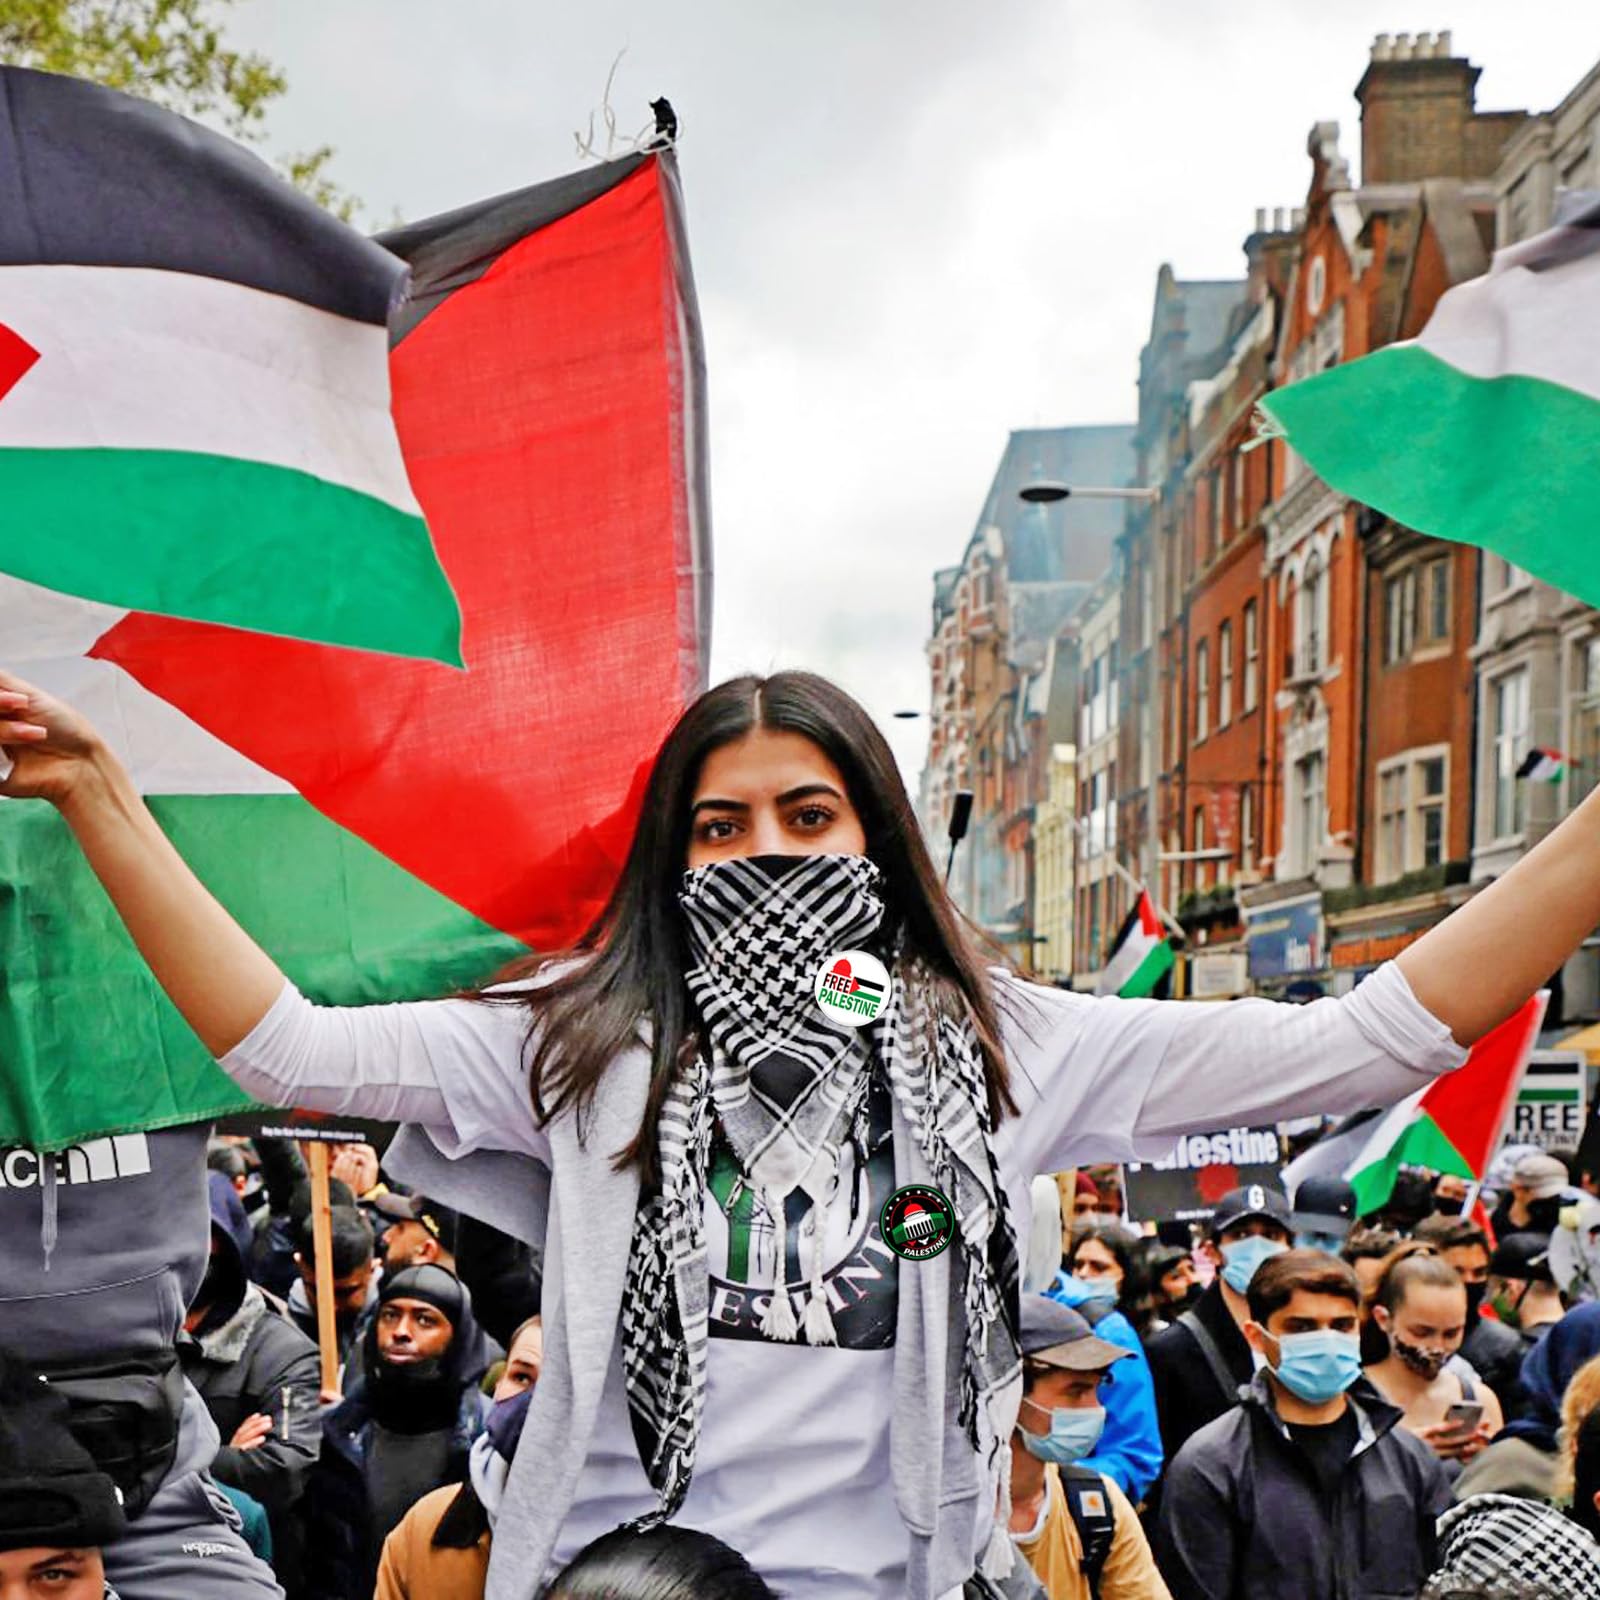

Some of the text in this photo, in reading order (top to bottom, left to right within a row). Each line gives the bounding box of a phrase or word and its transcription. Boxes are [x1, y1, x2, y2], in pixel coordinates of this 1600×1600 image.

[823, 973, 851, 994] FREE
[818, 988, 879, 1018] PALESTINE
[1515, 1104, 1579, 1131] REE
[1128, 1127, 1279, 1172] lestine
[903, 1235, 947, 1257] PALESTINE
